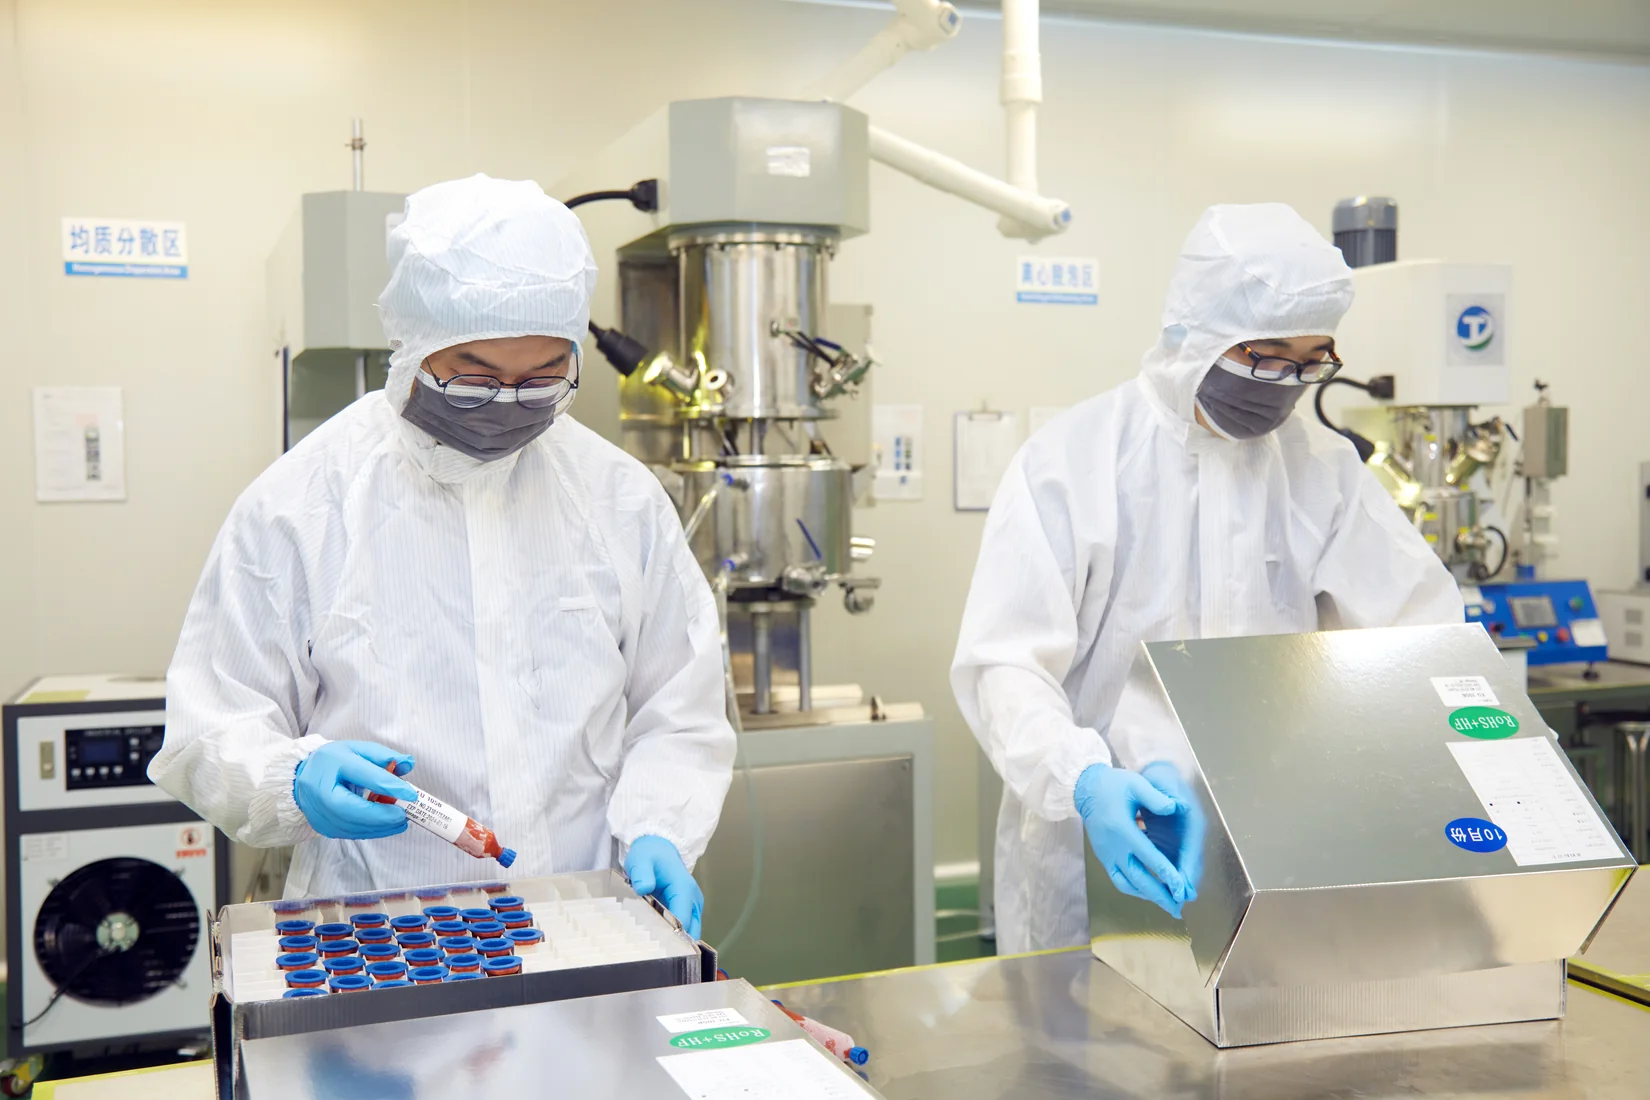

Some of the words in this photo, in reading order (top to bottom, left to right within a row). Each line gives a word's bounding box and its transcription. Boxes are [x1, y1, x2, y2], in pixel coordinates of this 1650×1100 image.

[70, 224, 181, 257] 均质分散区
[1454, 715, 1516, 731] RoHS+HF
[1450, 827, 1503, 843] 10月份
[678, 1028, 766, 1047] RoHS+HF
